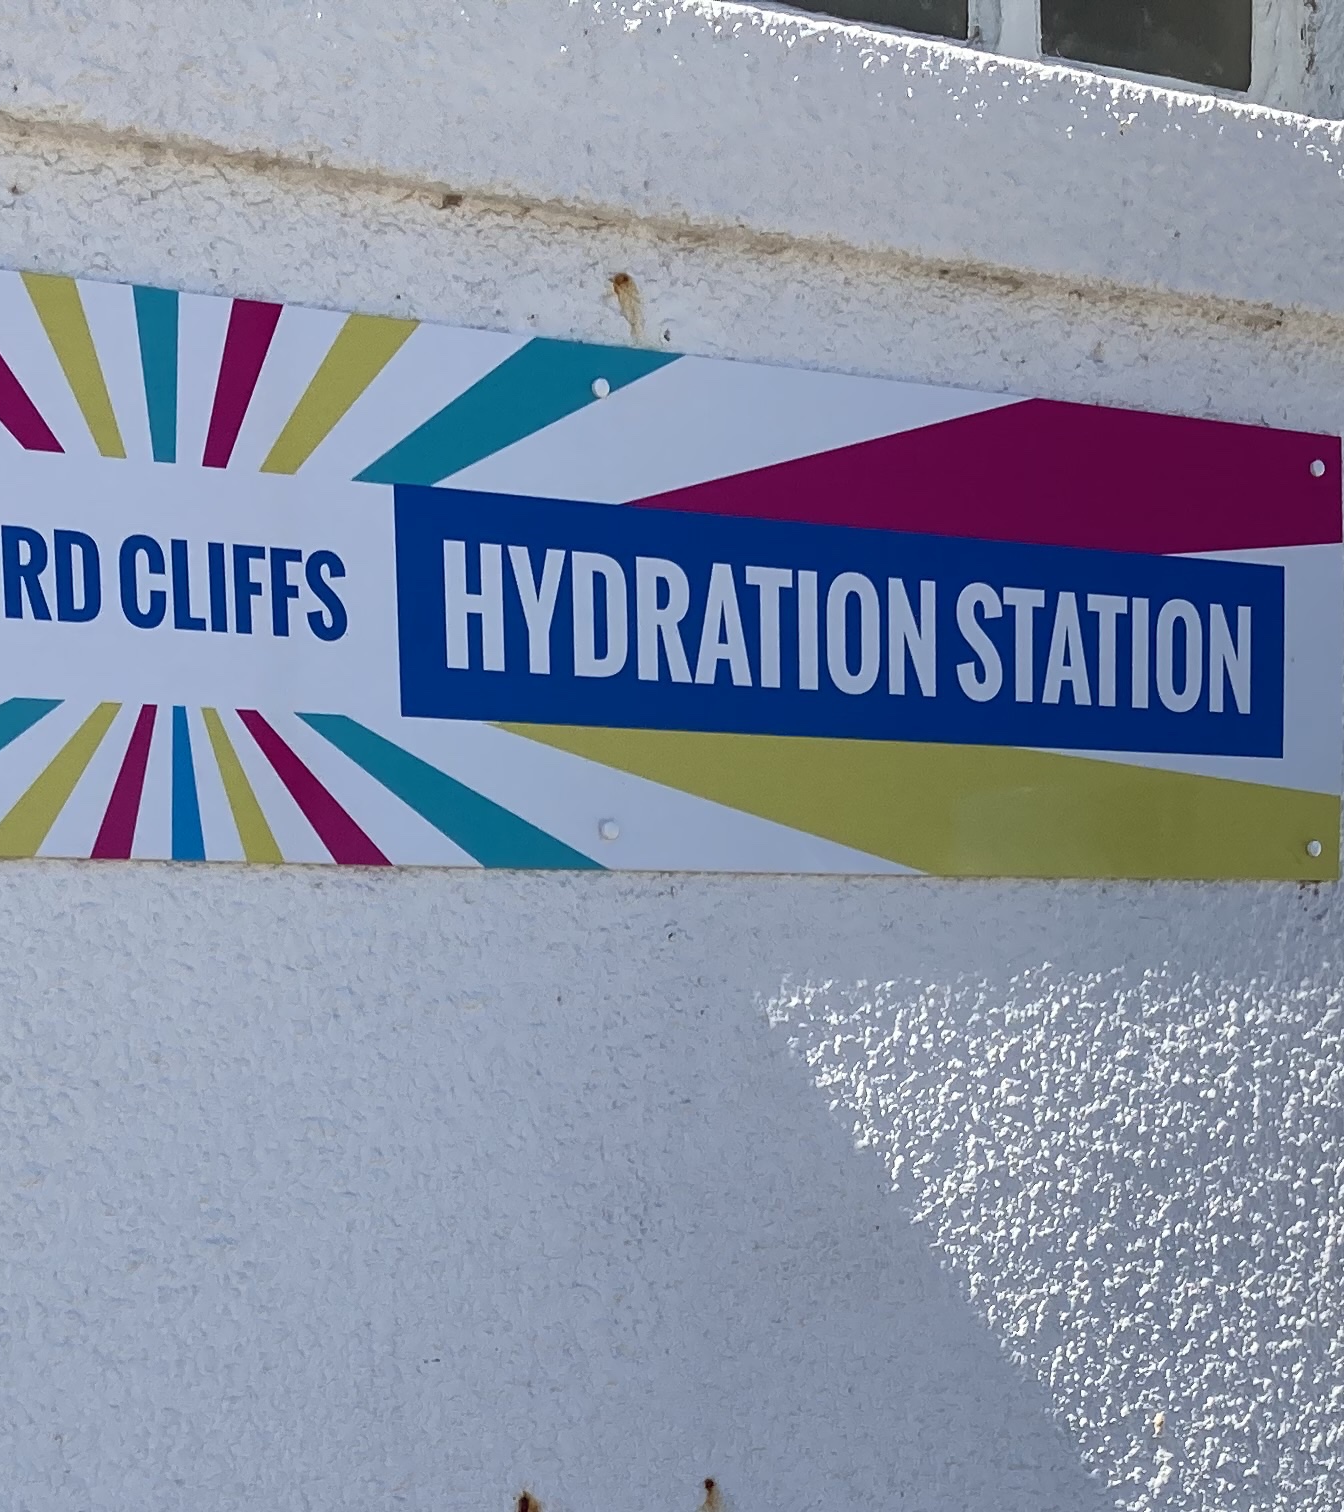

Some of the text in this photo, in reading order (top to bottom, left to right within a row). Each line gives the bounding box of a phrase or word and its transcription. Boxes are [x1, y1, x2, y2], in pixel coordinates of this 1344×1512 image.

[118, 533, 348, 642] CLIFFS
[442, 539, 1252, 715] HYDRATION STATION
